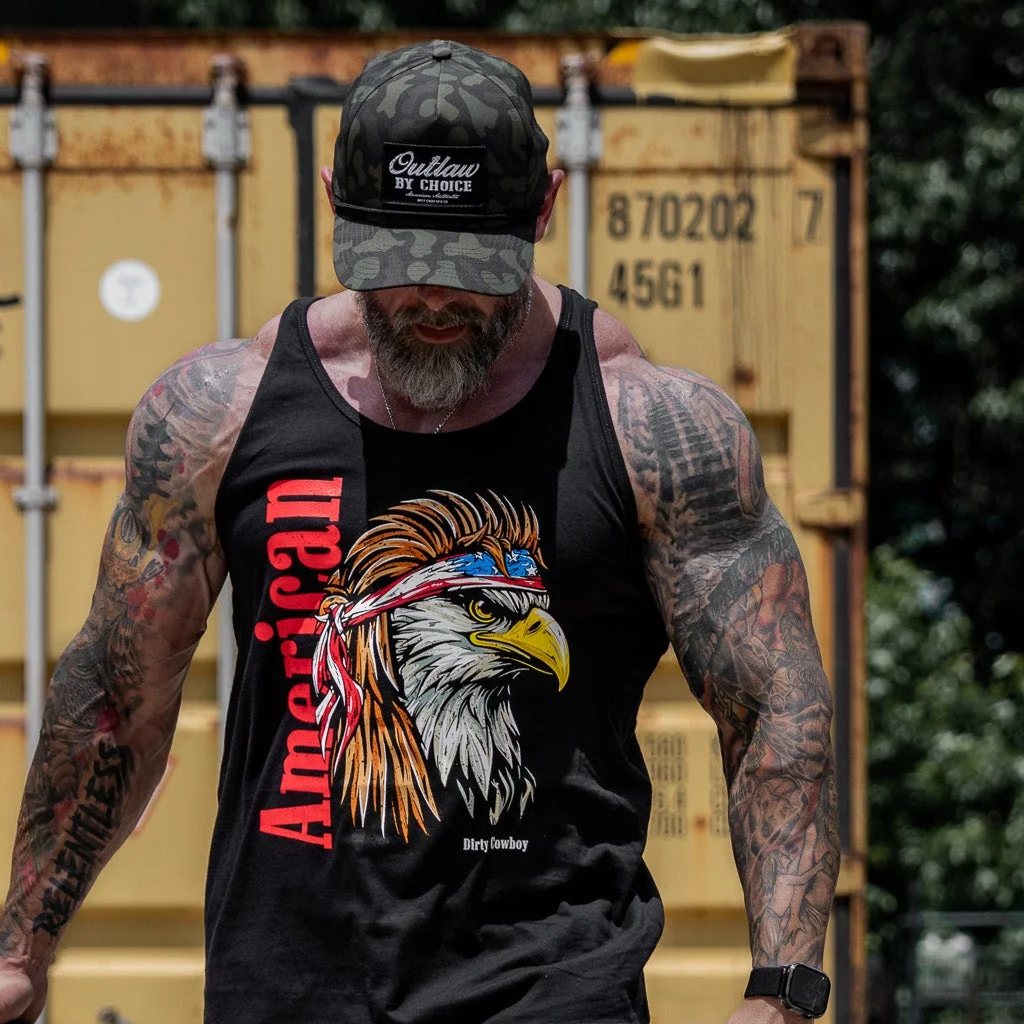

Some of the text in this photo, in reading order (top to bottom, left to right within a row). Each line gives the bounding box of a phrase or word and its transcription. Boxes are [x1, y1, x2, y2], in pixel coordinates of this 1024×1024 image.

[389, 151, 480, 178] Outlaw
[395, 177, 472, 192] BY CHOICE
[607, 190, 824, 242] 870202 7
[609, 260, 705, 308] 45G1
[254, 477, 343, 850] American
[32, 739, 135, 937] RELENTLESS
[463, 836, 529, 853] Dirty Cowboy
